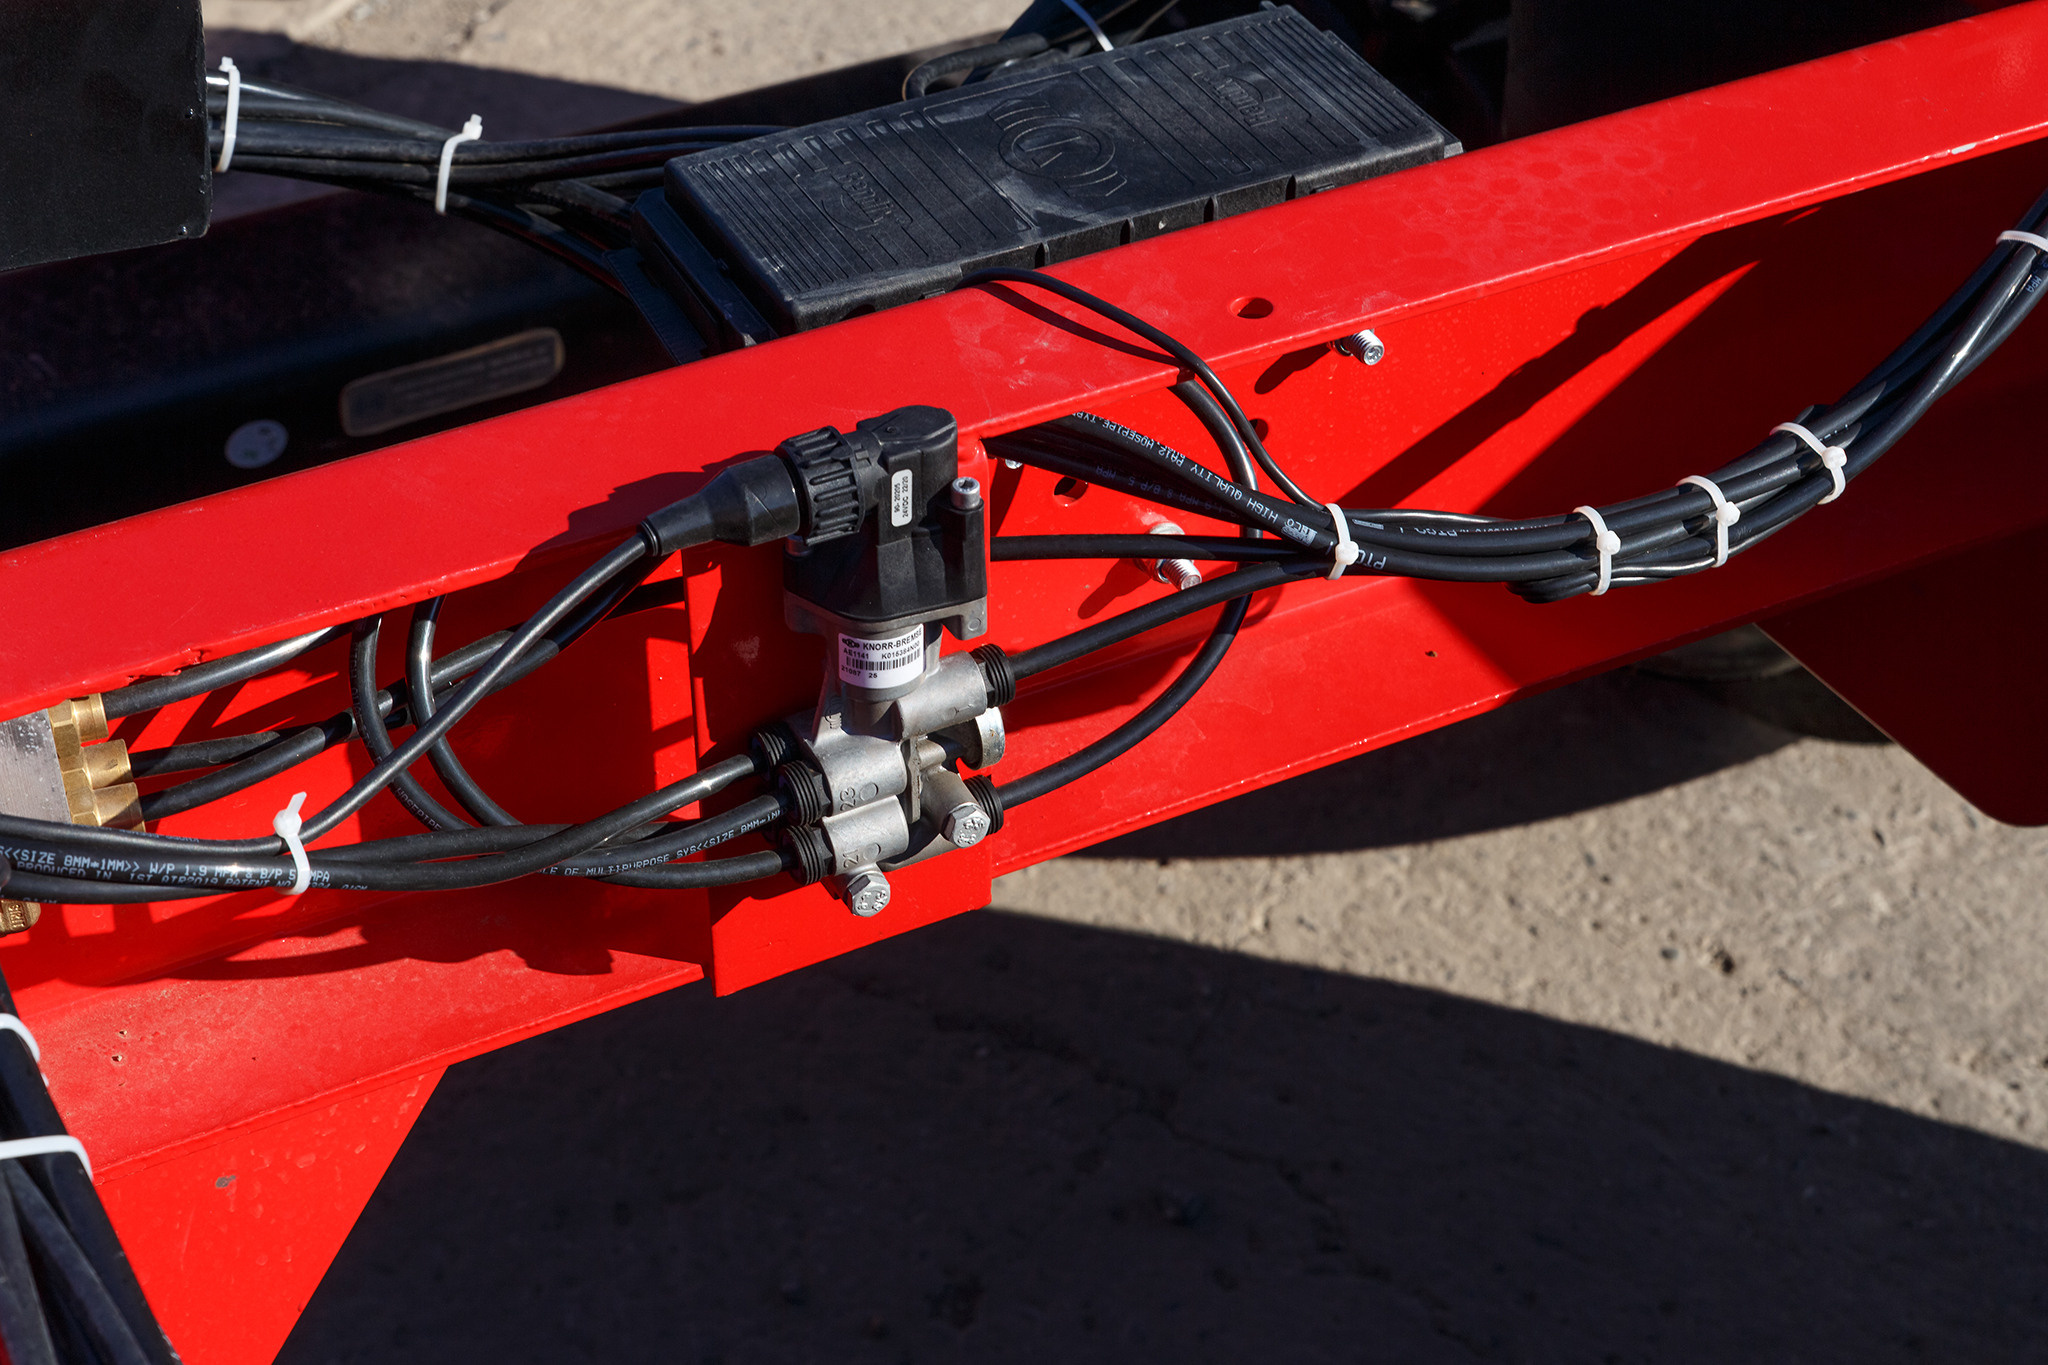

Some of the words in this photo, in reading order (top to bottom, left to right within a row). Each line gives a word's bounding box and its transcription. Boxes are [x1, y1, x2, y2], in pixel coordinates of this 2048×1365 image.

[1189, 463, 1244, 501] QUALITY
[1246, 497, 1279, 524] HIGH
[862, 628, 922, 651] KNORR-BREMSE
[843, 647, 870, 660] AE1141
[149, 862, 176, 875] W/P
[184, 864, 208, 877] 1.9
[244, 867, 254, 879] &
[259, 868, 283, 881] B/P
[288, 869, 297, 881] 5
